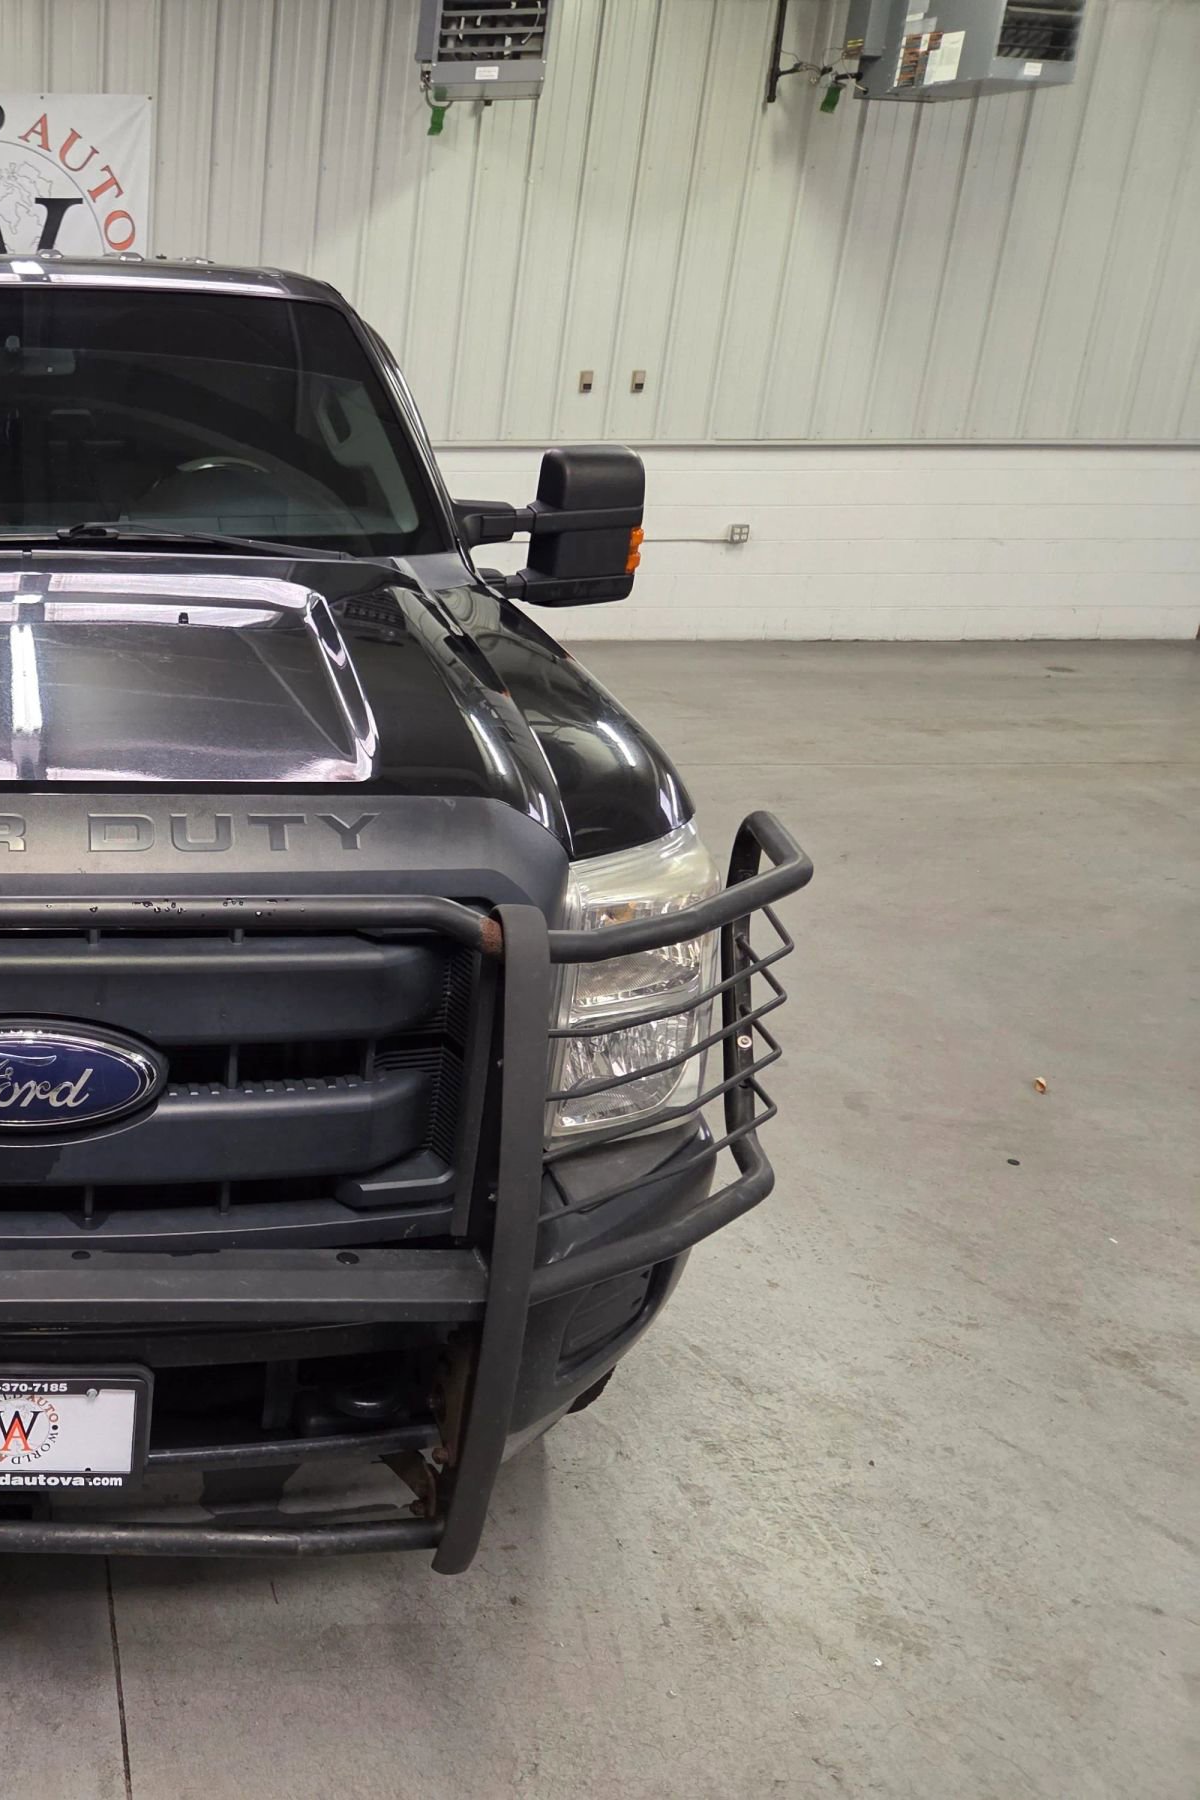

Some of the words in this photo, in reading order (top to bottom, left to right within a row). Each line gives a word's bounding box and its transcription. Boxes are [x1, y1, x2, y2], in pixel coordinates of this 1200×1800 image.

[18, 112, 136, 251] AUTO
[87, 812, 381, 852] DUTY
[26, 1394, 59, 1422] AUTO
[11, 1432, 59, 1465] WORLD
